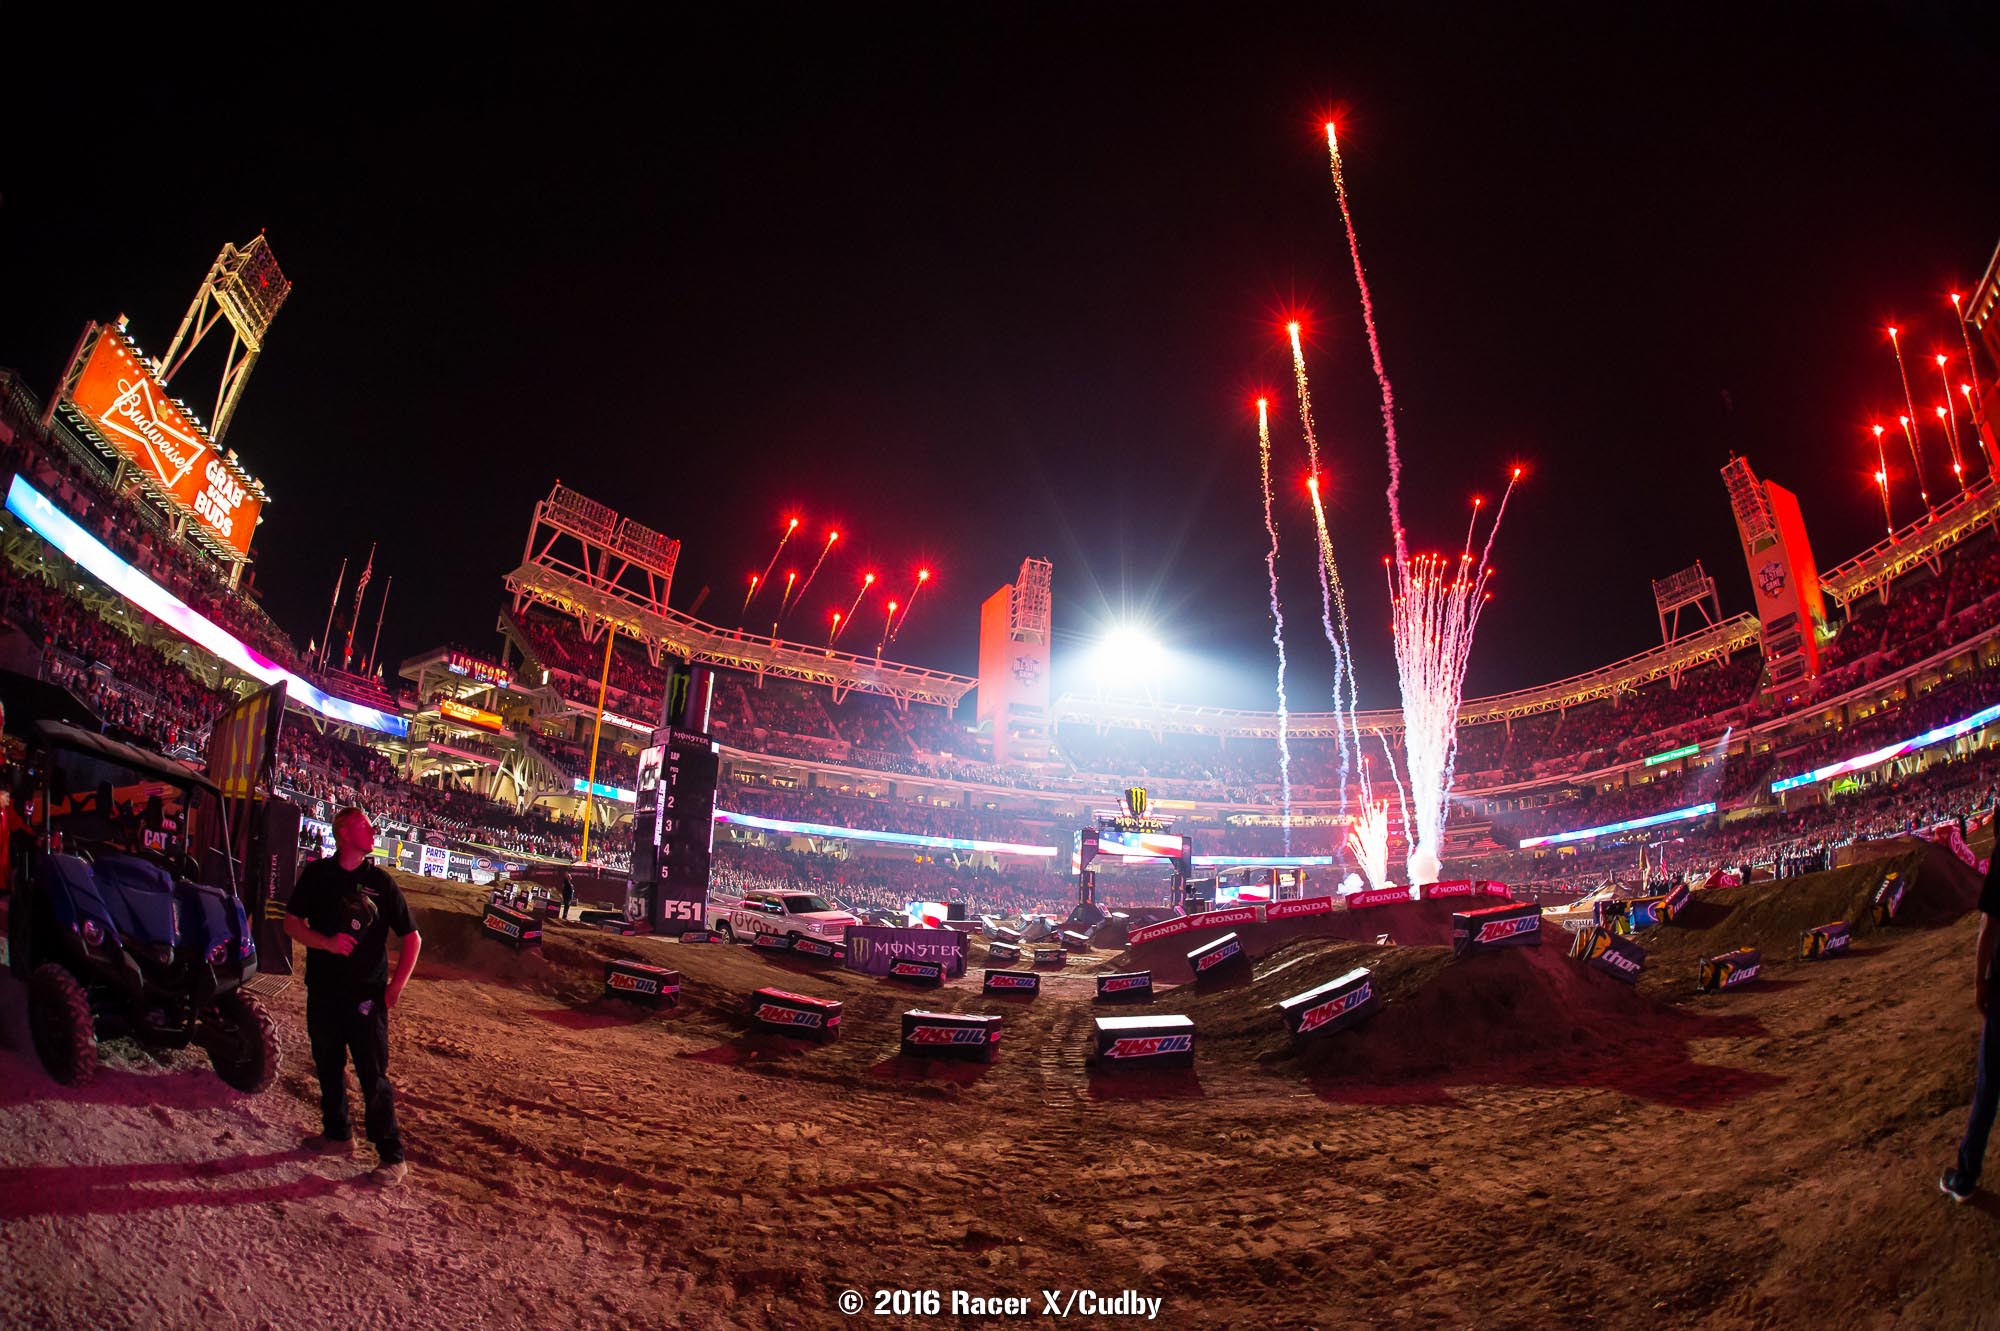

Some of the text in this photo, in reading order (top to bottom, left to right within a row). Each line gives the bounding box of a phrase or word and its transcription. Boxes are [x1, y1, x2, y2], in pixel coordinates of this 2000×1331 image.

[117, 378, 193, 475] Budweiser
[205, 459, 247, 509] GRAB
[206, 484, 233, 516] SOME
[193, 490, 233, 537] BUDS
[452, 654, 508, 684] LAS VEGAS
[444, 700, 480, 717] CYMER
[674, 731, 709, 745] MONSTER
[671, 774, 677, 785] 1
[668, 796, 674, 809] 2
[665, 819, 672, 832] 3
[1115, 817, 1163, 829] MONSTER
[143, 828, 168, 850] CAT
[425, 847, 446, 858] PARTS
[663, 843, 670, 856] 4
[661, 866, 668, 878] 5
[1365, 890, 1409, 903] HONDA
[1439, 884, 1470, 893] HONDA
[665, 899, 702, 921] FS1
[1282, 901, 1330, 914] HONDA
[483, 913, 519, 938] AMSOIL
[1205, 912, 1253, 925] HONDA
[1143, 921, 1188, 939] HONDA
[1474, 915, 1540, 944] AMSOIL
[874, 940, 963, 958] MONSTER
[1825, 934, 1849, 950] thor
[1196, 941, 1240, 972] AMSOIL
[1601, 949, 1641, 973] thor
[890, 962, 939, 977] AMSOIL
[1727, 964, 1761, 984] thor
[607, 971, 657, 995] AMSOIL
[986, 975, 1037, 988] AMSOIL
[1100, 976, 1150, 992] AMSOIL
[1297, 980, 1372, 1033] AMSOIL
[753, 1003, 823, 1029] AMSOIL
[906, 1025, 987, 1045] AMSOIL
[1104, 1034, 1192, 1059] AMSOIL
